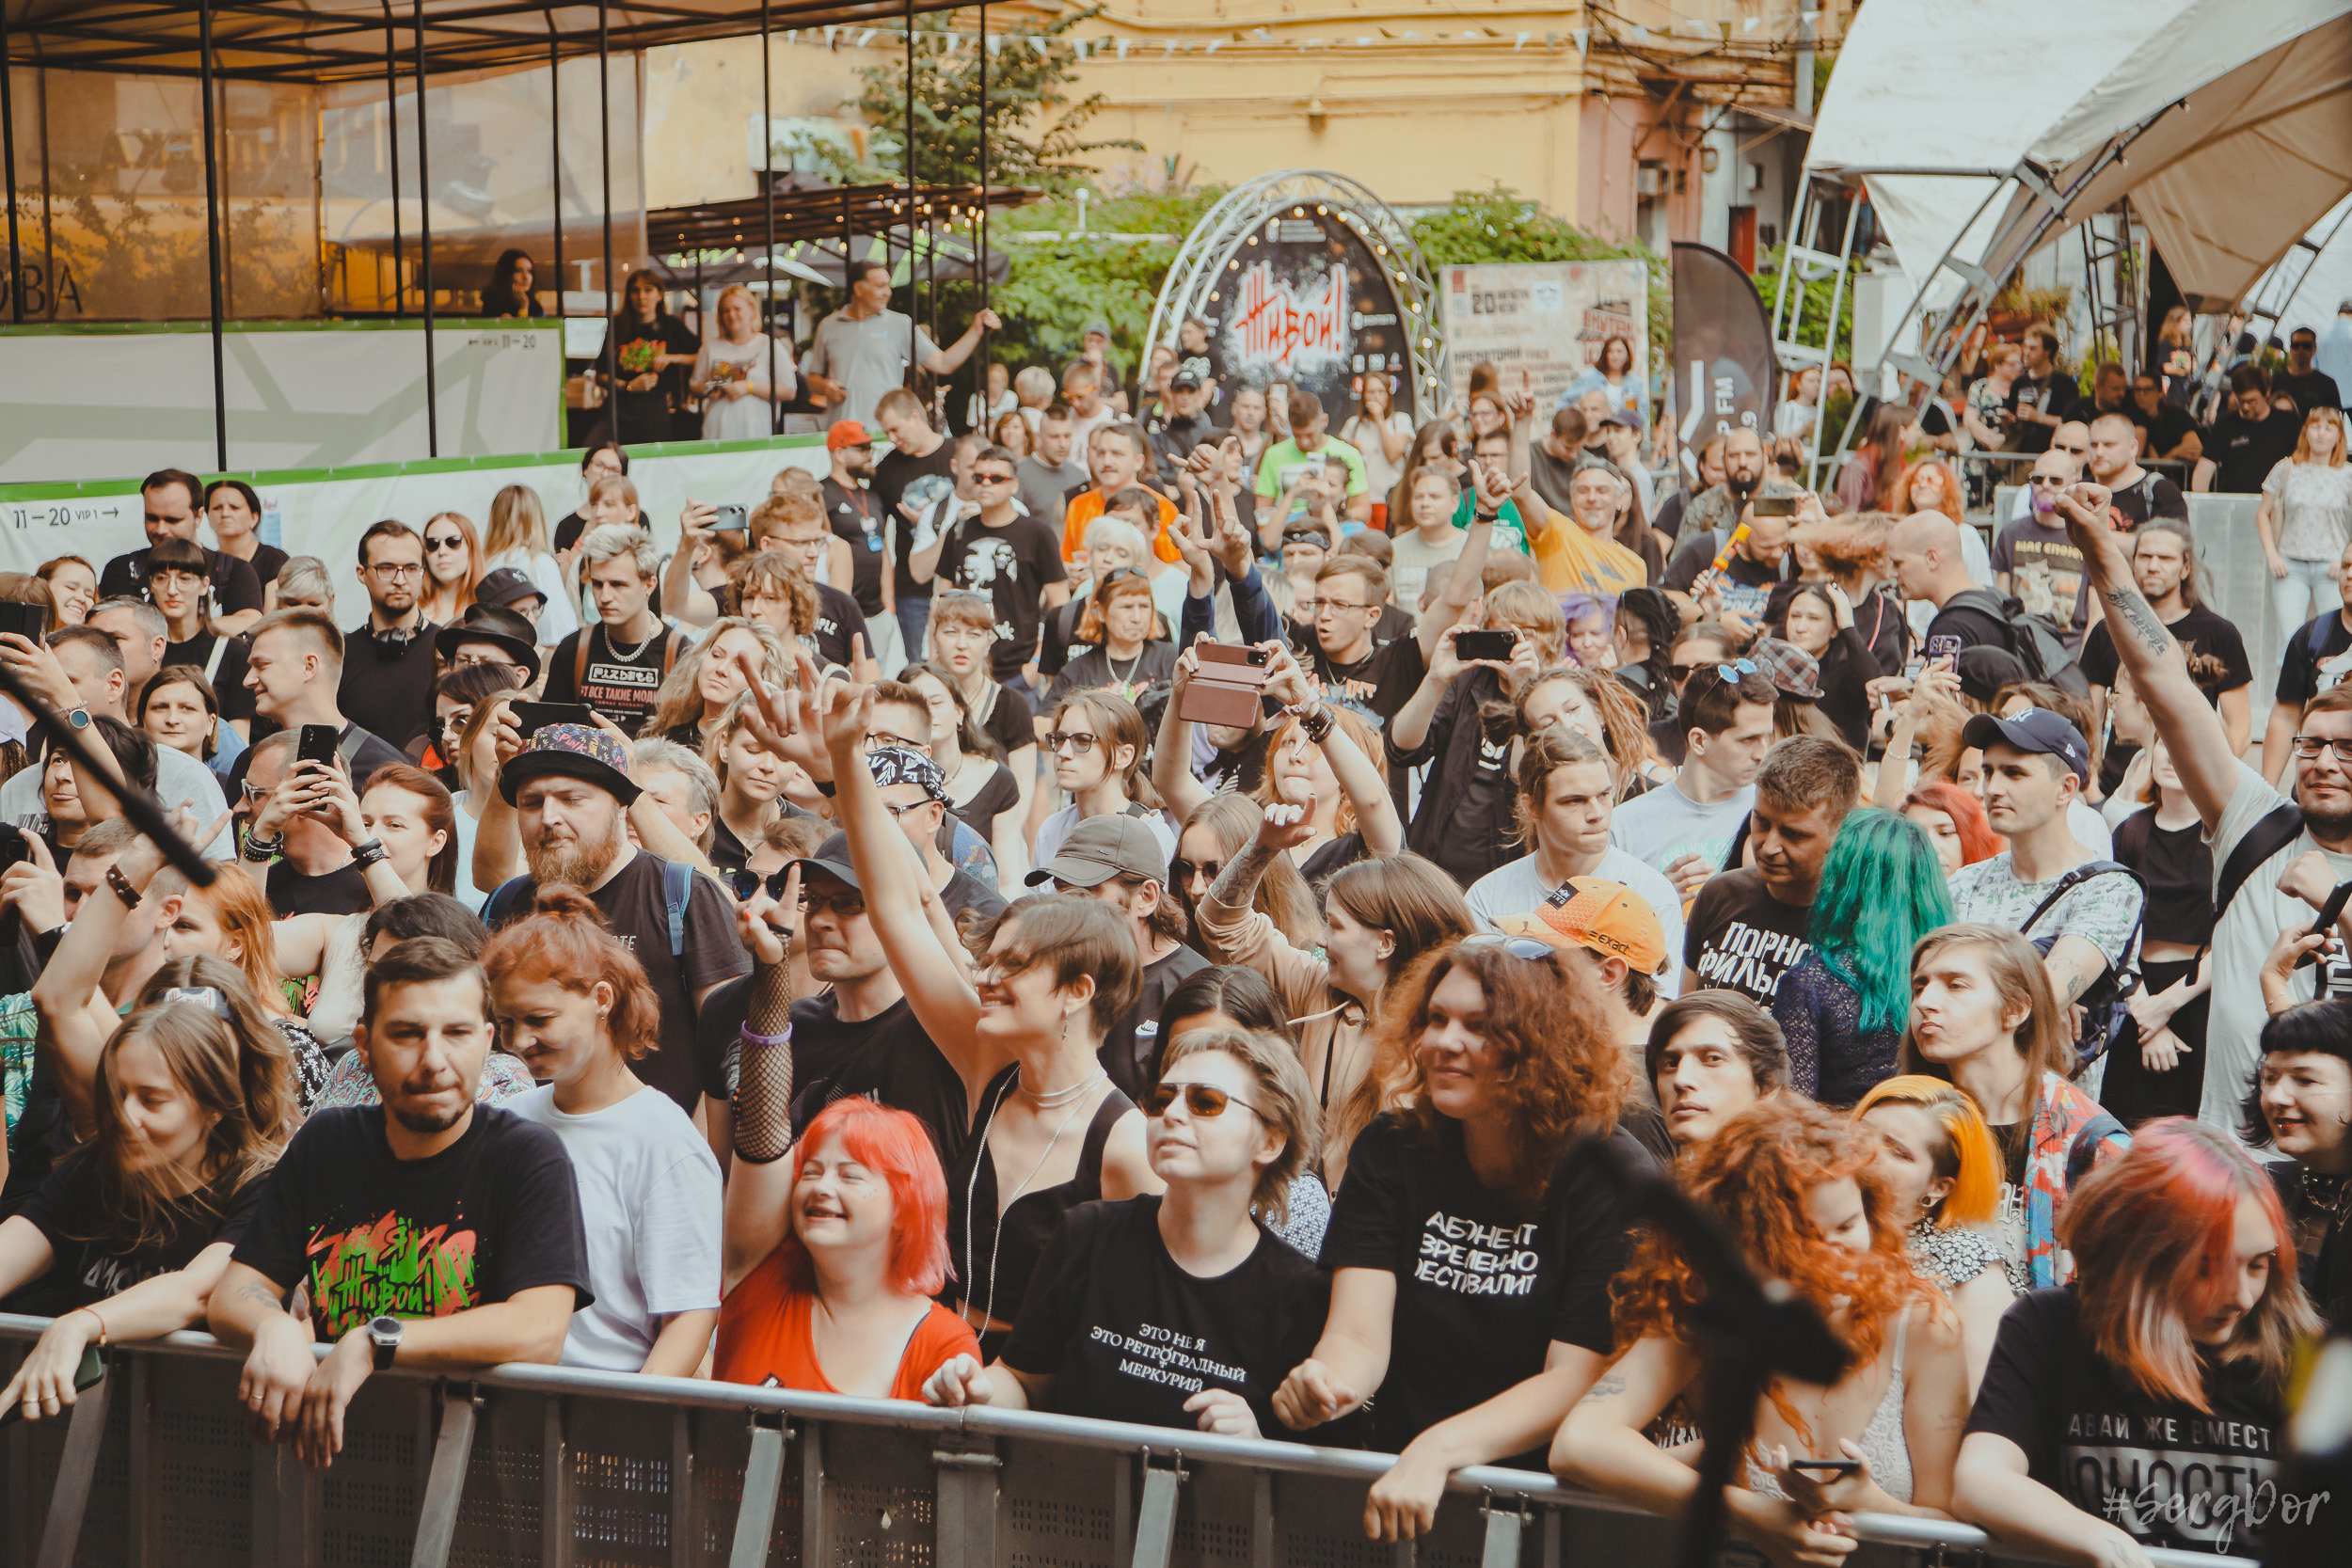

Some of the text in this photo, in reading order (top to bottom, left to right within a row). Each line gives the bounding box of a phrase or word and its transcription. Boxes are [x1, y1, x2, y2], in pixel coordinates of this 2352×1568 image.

[75, 510, 91, 520] VIP
[589, 686, 604, 699] ВСЕ
[605, 687, 632, 702] ТАКИЕ
[1090, 1325, 1248, 1383] ЭТО РЕТРОГРАДНЫЙ
[1138, 1323, 1207, 1353] ЭТО НЕ Я
[1119, 1358, 1204, 1393] МЕРКУРИЙ
[2069, 1412, 2272, 1452] АВАЙ ЖЕ ВМЕСТ
